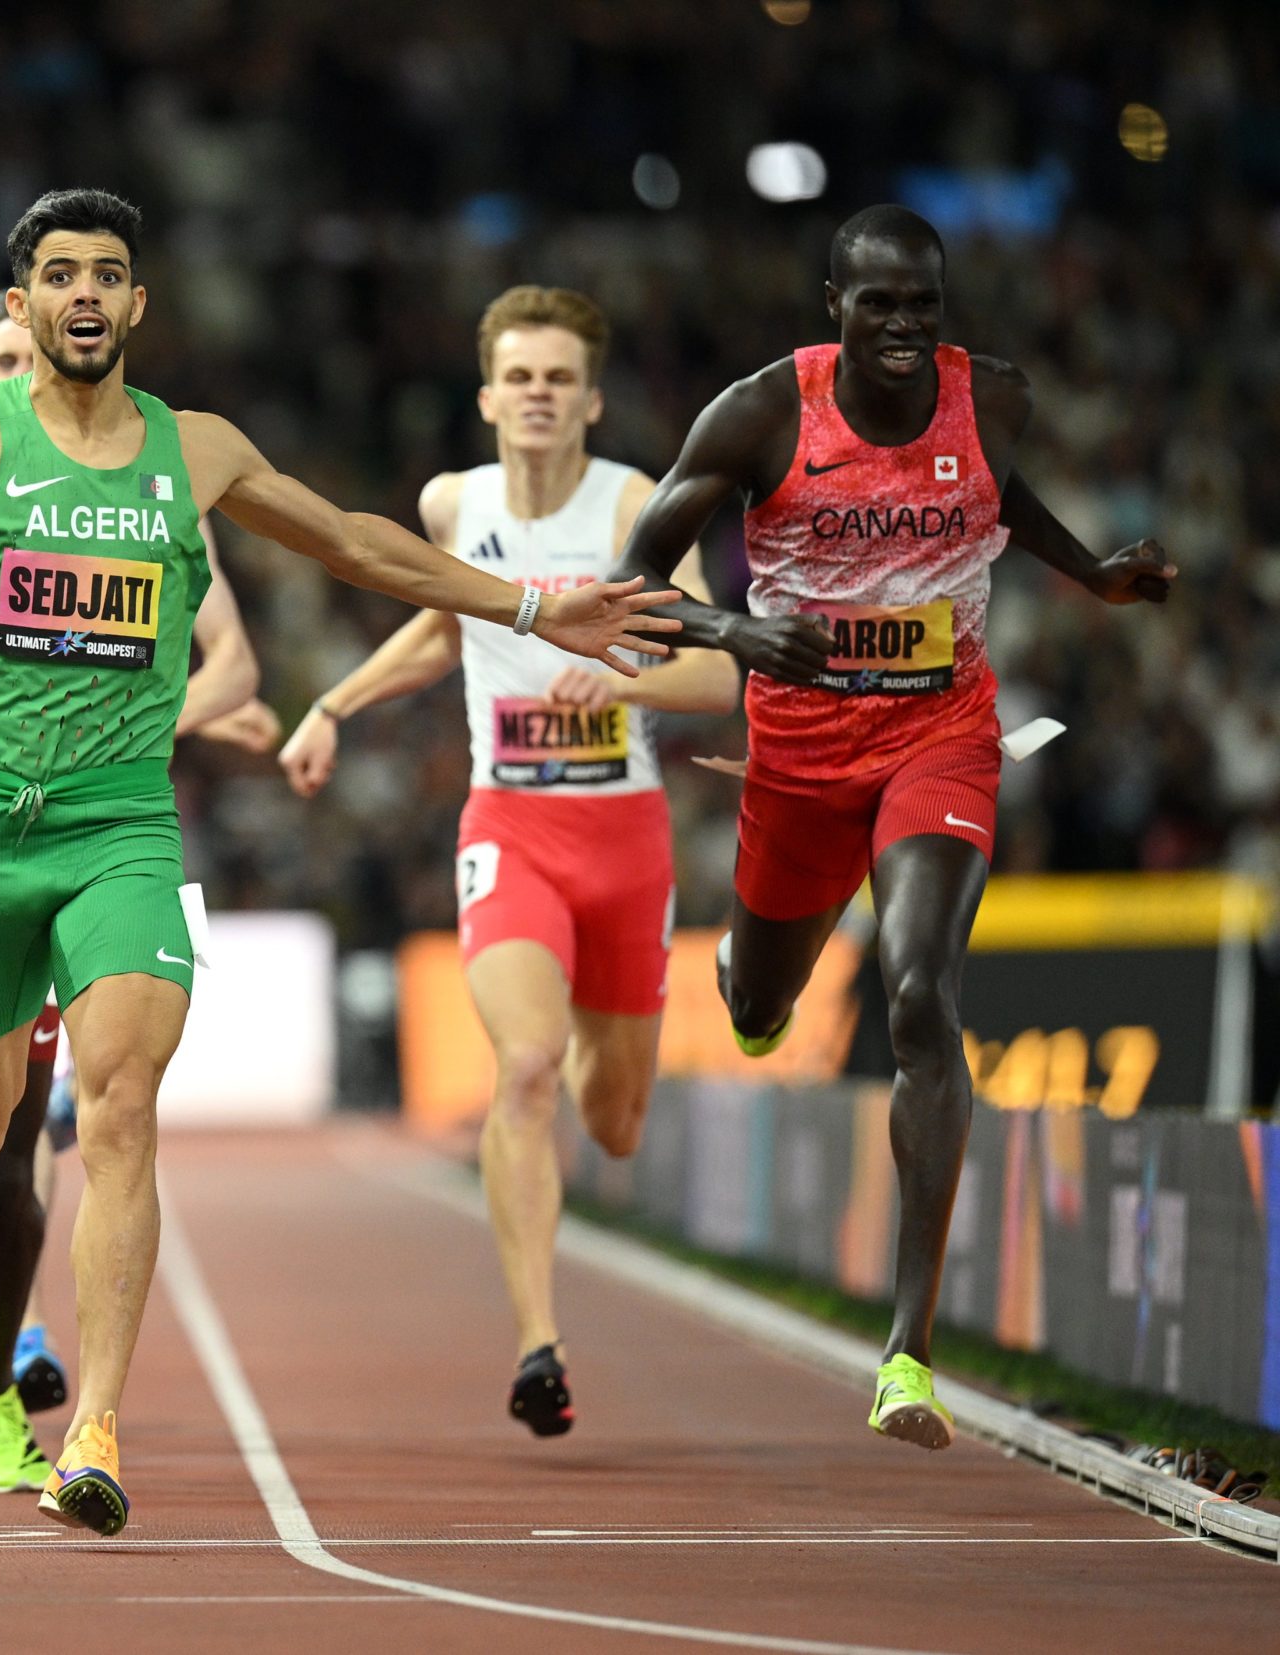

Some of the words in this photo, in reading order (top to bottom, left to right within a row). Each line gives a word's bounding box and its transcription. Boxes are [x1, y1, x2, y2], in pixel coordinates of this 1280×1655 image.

[25, 504, 170, 543] ALGERIA
[812, 506, 966, 539] CANADA
[8, 566, 154, 625] SEDJATI
[5, 633, 51, 651] ULTIMATE
[86, 642, 136, 658] BUDAPEST
[830, 618, 925, 660] AROP
[882, 675, 931, 688] BUDAPEST
[500, 709, 619, 747] MEZIANE
